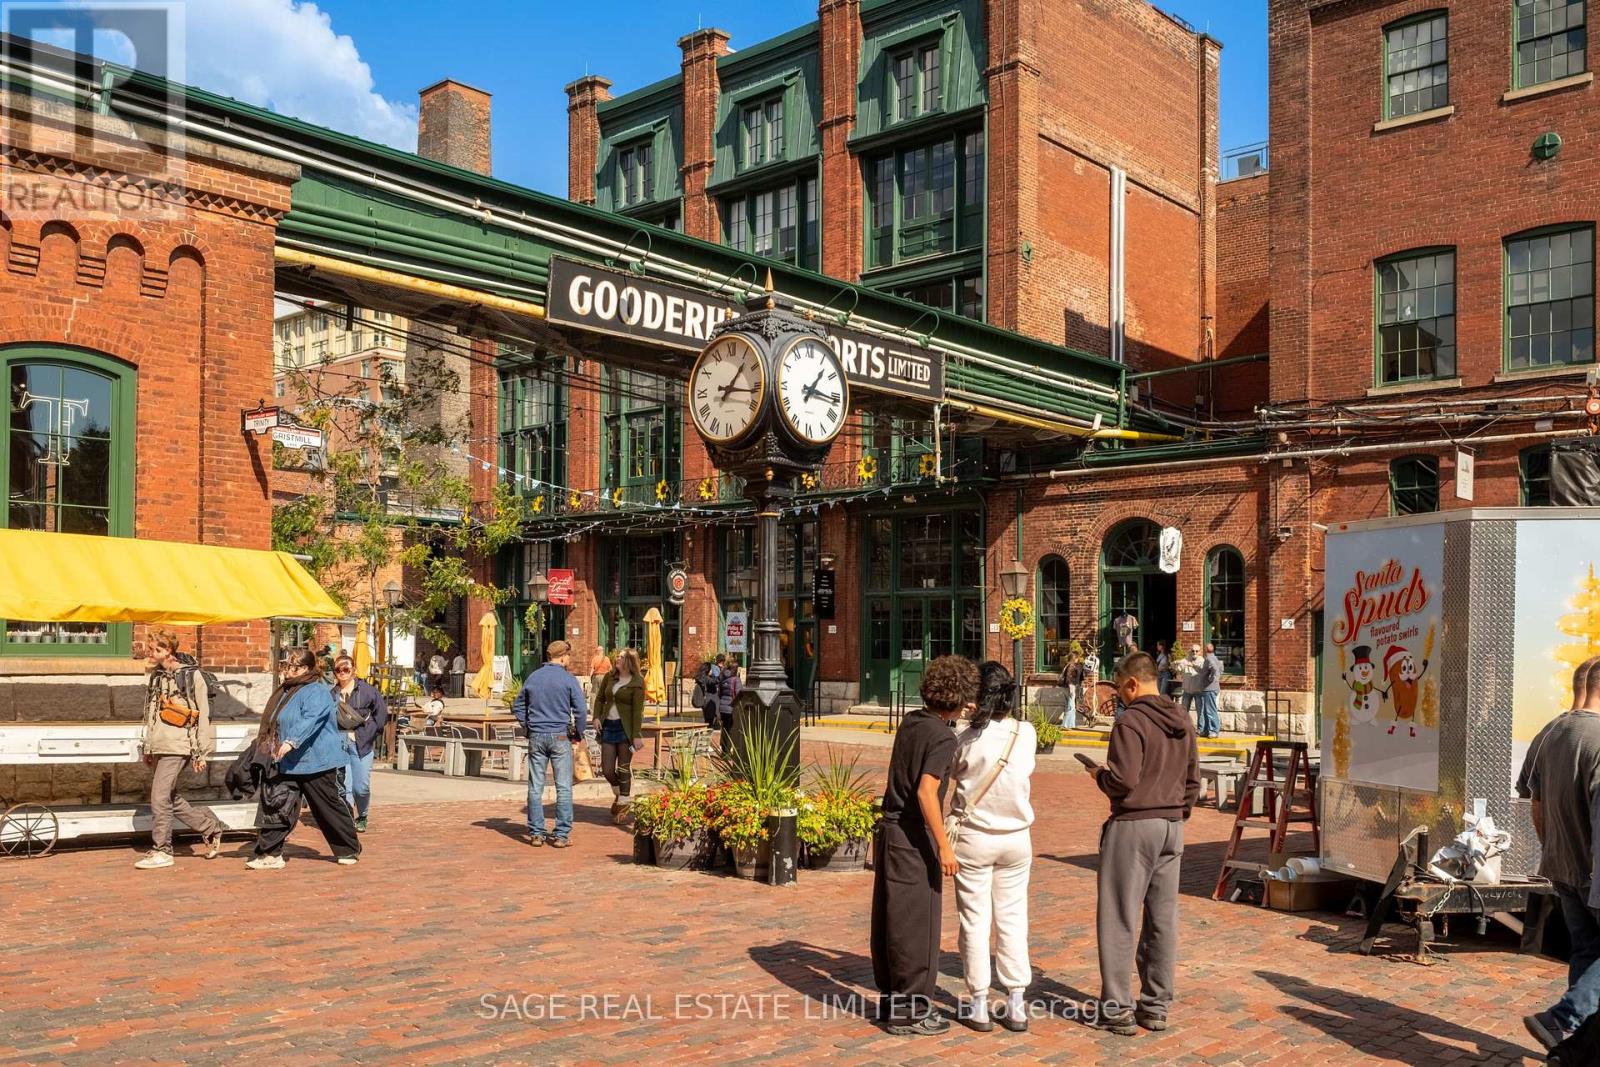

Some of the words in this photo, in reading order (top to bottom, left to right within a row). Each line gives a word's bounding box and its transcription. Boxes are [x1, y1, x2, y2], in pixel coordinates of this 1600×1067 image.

[888, 356, 931, 382] LIMITED
[272, 432, 312, 444] GRISTMILL
[1356, 559, 1403, 598] Santa
[1331, 567, 1428, 645] Spuds
[1370, 621, 1400, 638] flavoured
[1376, 633, 1398, 649] potato
[1398, 626, 1419, 641] swirls
